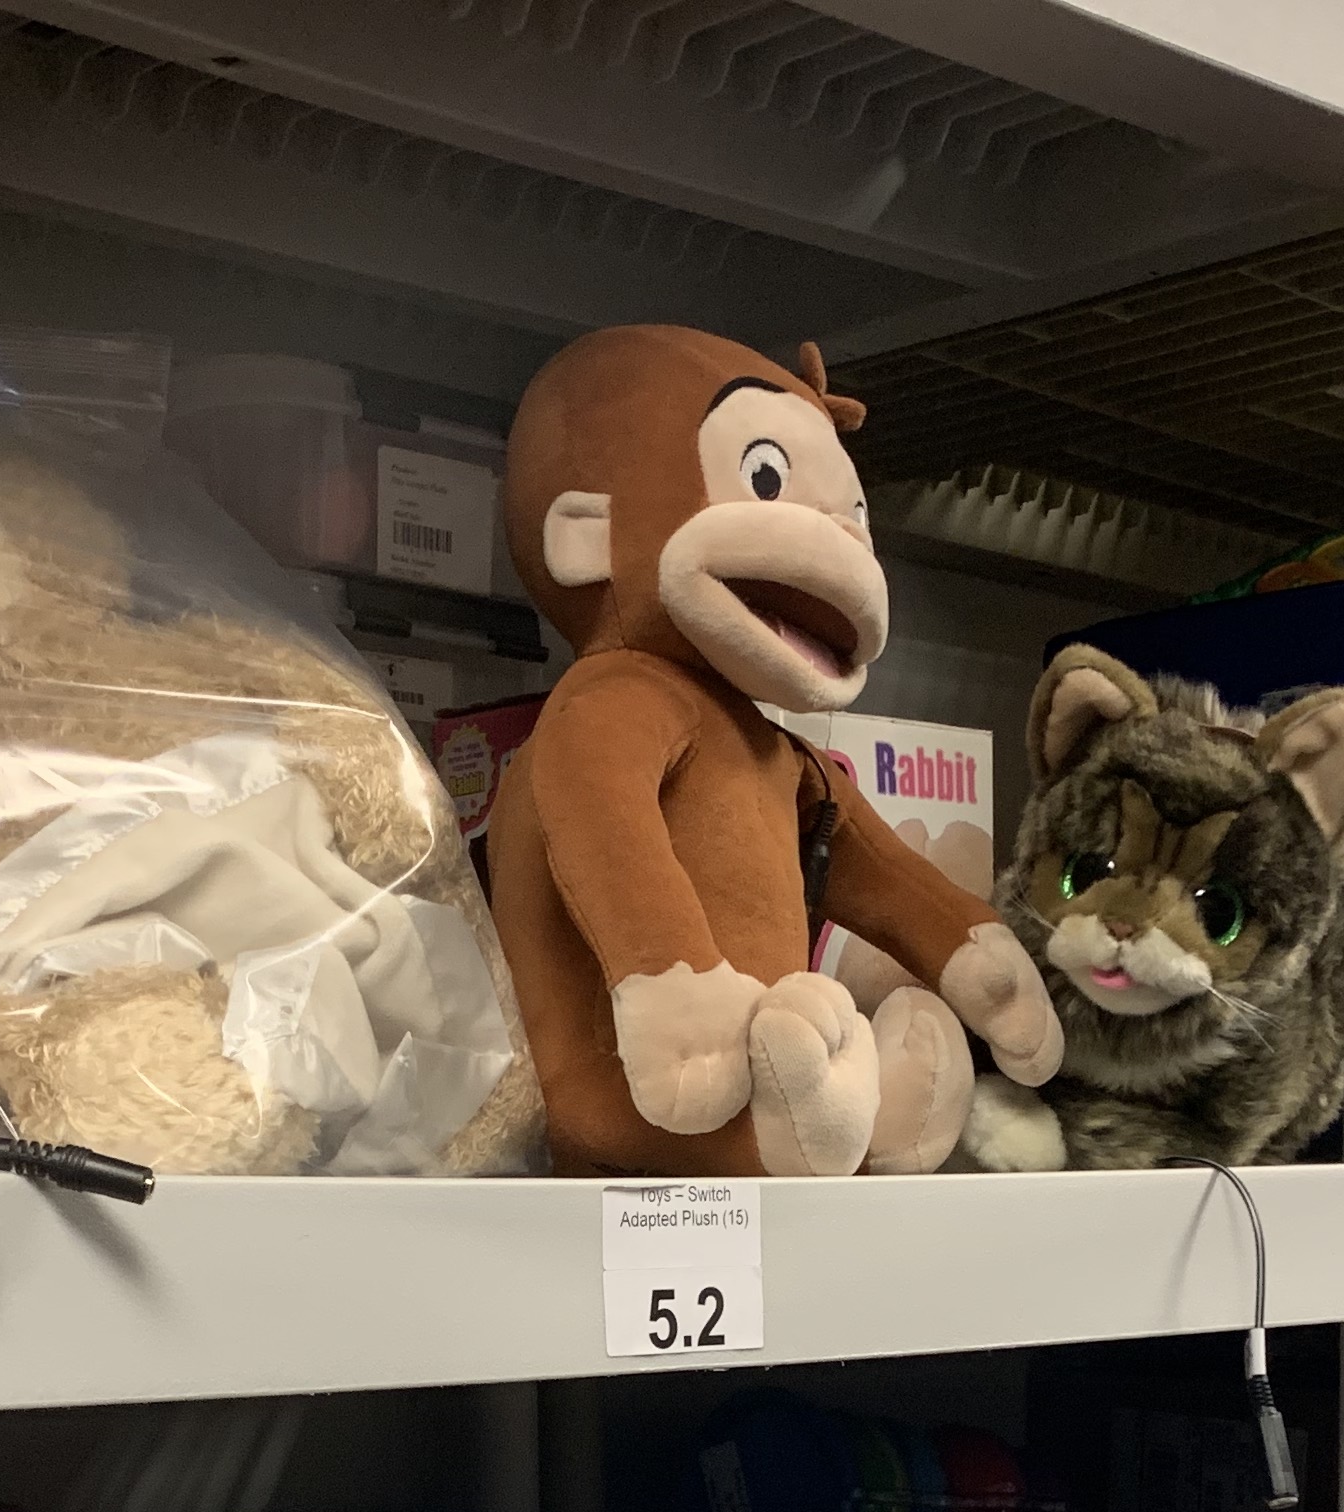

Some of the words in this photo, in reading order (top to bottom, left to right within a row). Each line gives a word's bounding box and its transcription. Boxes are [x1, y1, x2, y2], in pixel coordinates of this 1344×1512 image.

[875, 740, 978, 805] Rabbit
[639, 1187, 670, 1207] Toys
[687, 1186, 731, 1203] Switch
[620, 1210, 678, 1231] Adapted
[682, 1208, 719, 1228] Plush
[722, 1208, 749, 1229] (15)
[648, 1286, 726, 1349] 5.2
